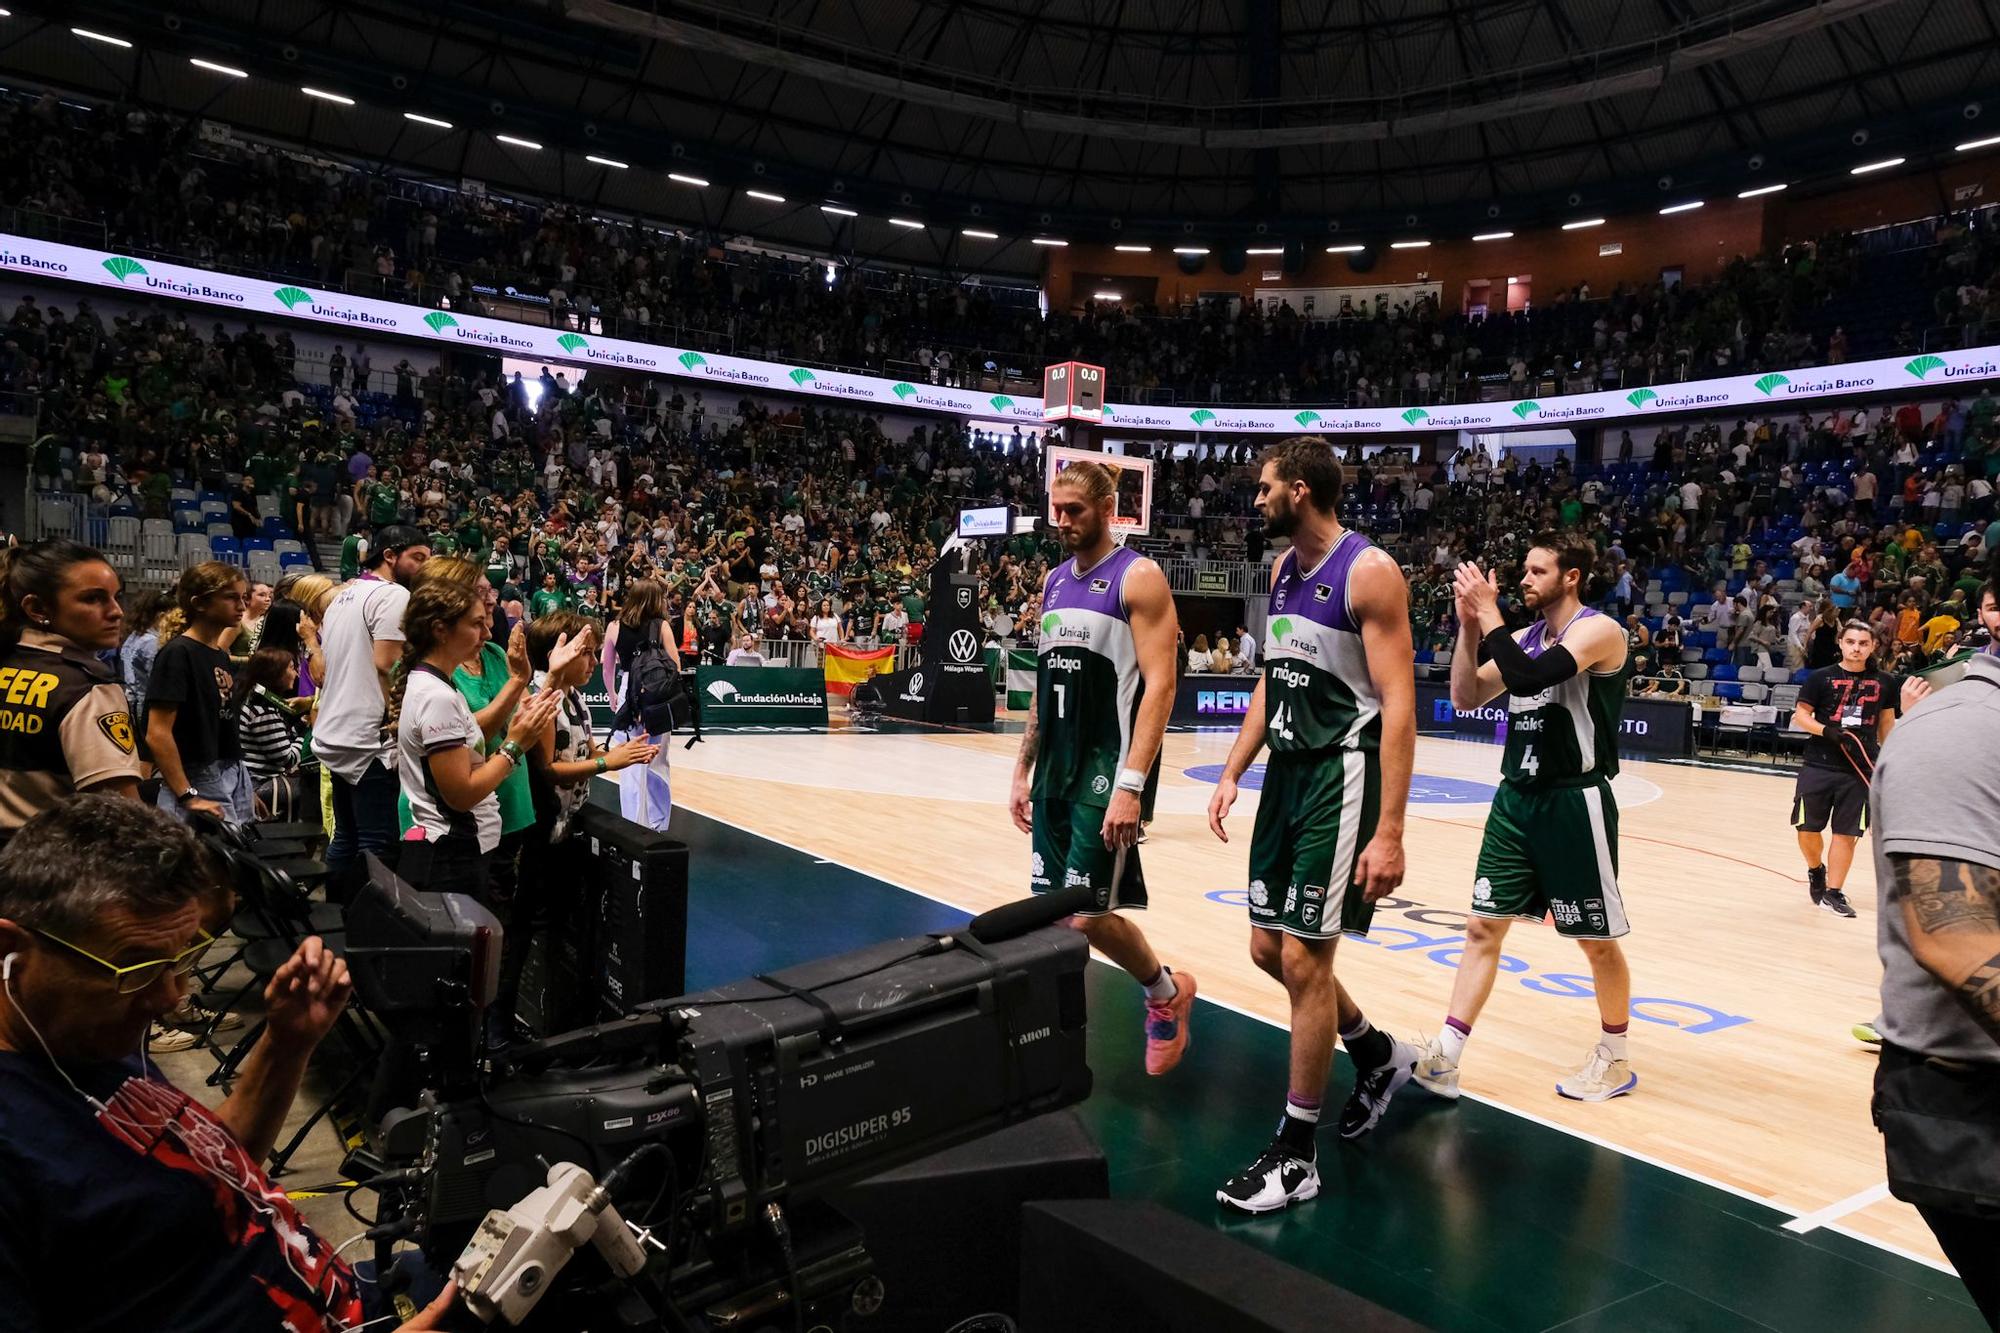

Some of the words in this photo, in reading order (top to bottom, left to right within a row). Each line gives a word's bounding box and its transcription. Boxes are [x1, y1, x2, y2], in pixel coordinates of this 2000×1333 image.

[21, 254, 68, 272] Banco
[146, 277, 200, 296] Unicaja
[203, 287, 244, 301] Banco
[312, 305, 359, 321] Unicaja
[361, 313, 397, 326] Banco
[457, 329, 499, 343] Unicaja
[501, 335, 534, 347] Banco
[588, 349, 625, 363] Unicaja
[627, 355, 657, 366] Banco
[706, 367, 741, 379] Unicaja
[742, 372, 770, 382] Banco
[1051, 367, 1066, 381] 0.0
[1081, 368, 1098, 382] 0.0
[1945, 362, 1997, 377] Unicaja
[814, 381, 847, 394] Unicaja
[848, 387, 874, 396] Banco
[1788, 381, 1834, 393] Unicaja
[1836, 379, 1874, 388] Banco
[917, 396, 947, 407] Unicaja
[948, 400, 972, 409] Banco
[1656, 394, 1694, 408] Unicaja
[1697, 394, 1728, 404] Banco
[1013, 408, 1044, 418] Unicaja
[1113, 415, 1142, 426] Unicaja
[1144, 417, 1171, 426] Banco
[1540, 407, 1574, 419] Unicaja
[1576, 407, 1604, 416] Banco
[1215, 419, 1247, 430] Unicaja
[1249, 420, 1274, 429] Banco
[1320, 420, 1352, 430] Unicaja
[1354, 420, 1381, 428] Banco
[1428, 416, 1461, 427] Unicaja
[1463, 416, 1491, 424] Banco
[944, 665, 964, 673] Málaga
[734, 692, 823, 706] FundaciónUnicaja
[1053, 684, 1065, 719] 1
[1197, 691, 1253, 713] RED
[0, 710, 44, 734] DAD
[1617, 719, 1648, 735] TO
[1519, 744, 1540, 776] 4
[1009, 1026, 1052, 1047] anon
[799, 1073, 818, 1089] HD
[823, 1069, 844, 1082] IMAGE
[845, 1059, 876, 1075] STABILIZER
[805, 1114, 889, 1157] DIGISUPER
[891, 1105, 912, 1127] 95
